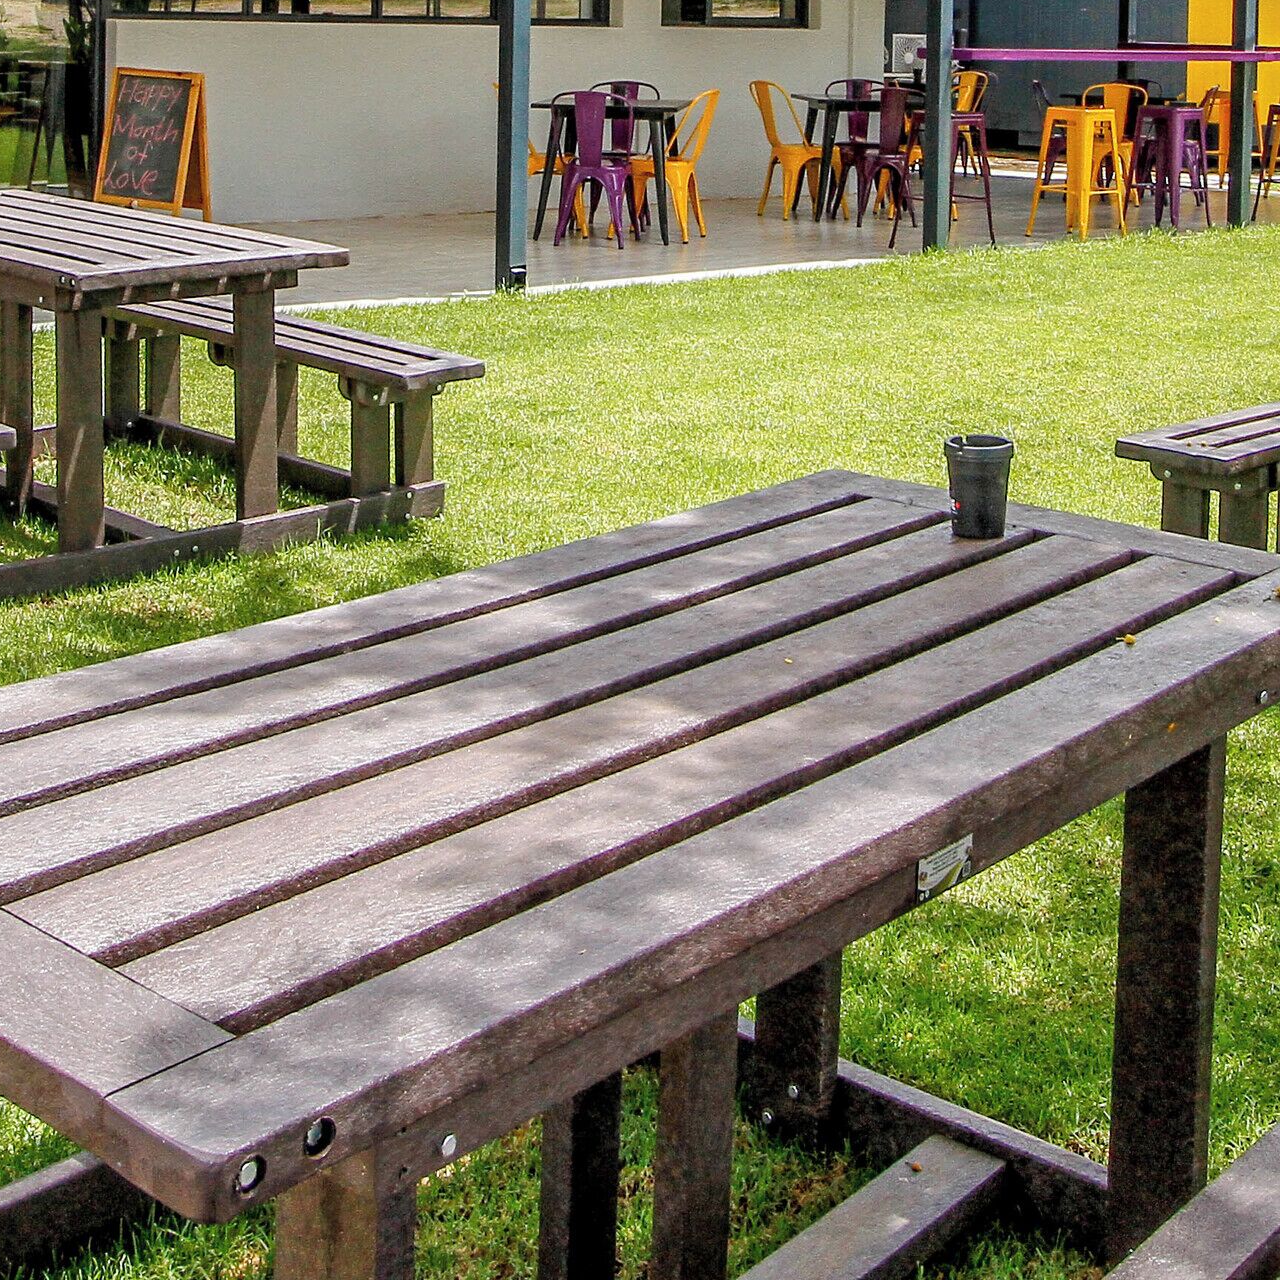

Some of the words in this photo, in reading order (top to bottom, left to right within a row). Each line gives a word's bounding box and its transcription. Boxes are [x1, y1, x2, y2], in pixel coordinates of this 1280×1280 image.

[118, 78, 183, 111] Happy
[113, 114, 178, 144] Month
[124, 140, 153, 165] of
[104, 161, 158, 196] Love
